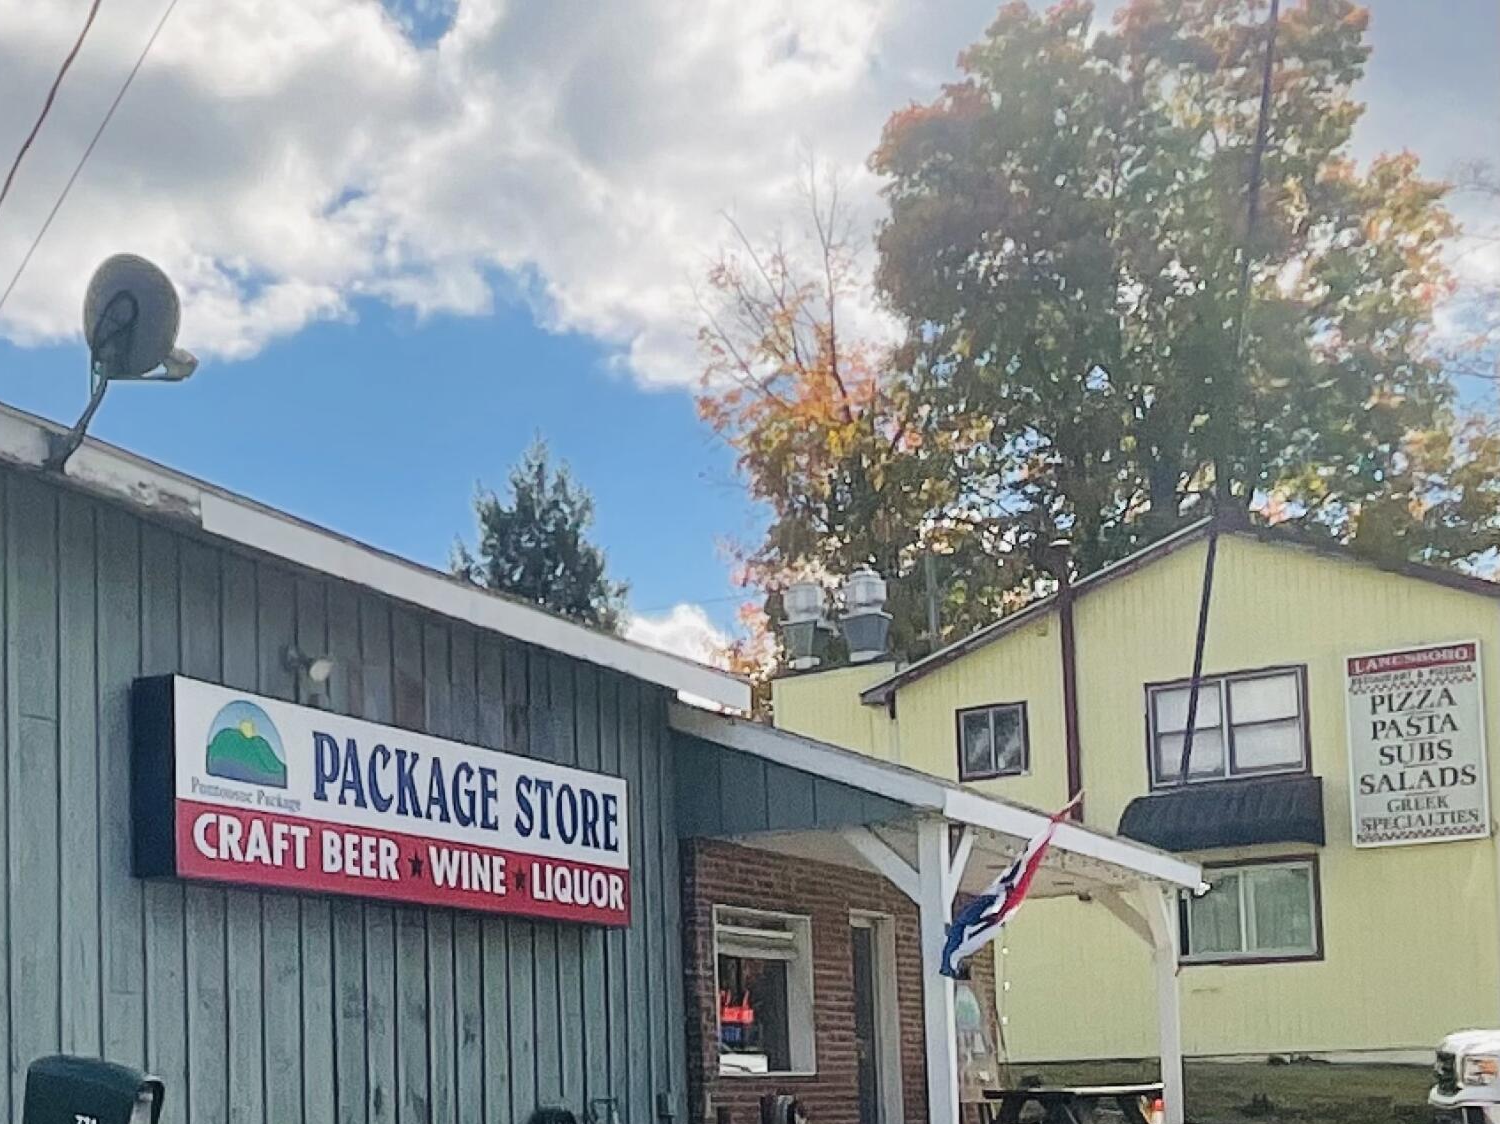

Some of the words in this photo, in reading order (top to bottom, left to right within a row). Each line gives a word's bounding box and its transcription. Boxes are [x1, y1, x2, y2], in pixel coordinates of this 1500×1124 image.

[1371, 687, 1458, 715] PIZZA
[1371, 713, 1459, 741] PASTA
[1379, 739, 1453, 766] SUBS
[312, 731, 499, 831] PACKAGE
[515, 774, 619, 852] STORE
[1360, 764, 1476, 795] SALADS
[1387, 795, 1449, 812] GREEK
[1361, 809, 1479, 831] SPECIALTIES
[193, 813, 310, 870] CRAFT
[322, 830, 400, 880] BEER
[428, 845, 506, 895] WINE
[532, 862, 625, 911] LIQUOR
